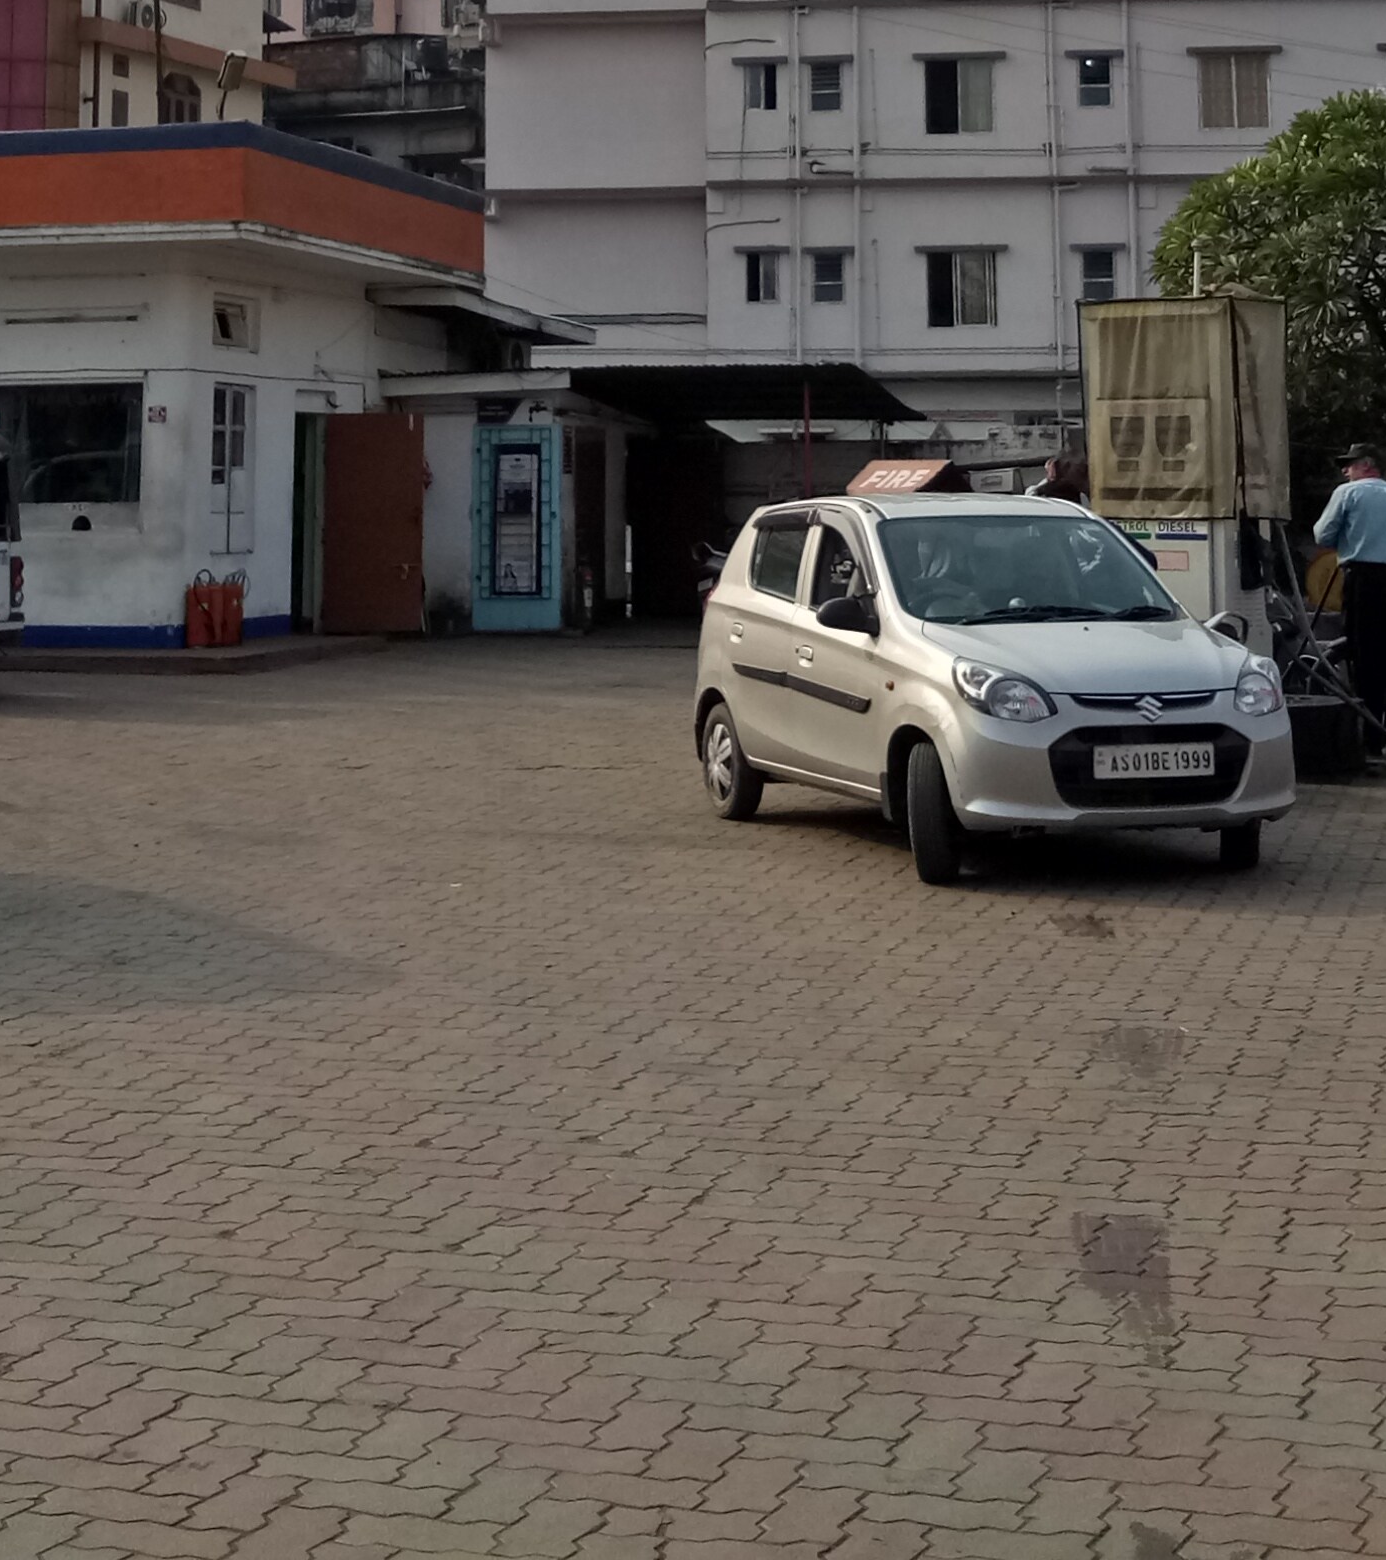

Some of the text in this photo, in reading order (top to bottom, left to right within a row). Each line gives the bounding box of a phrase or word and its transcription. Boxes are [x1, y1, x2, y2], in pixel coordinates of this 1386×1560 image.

[859, 469, 931, 488] FIRE
[1116, 520, 1197, 533] TROL DIESEL
